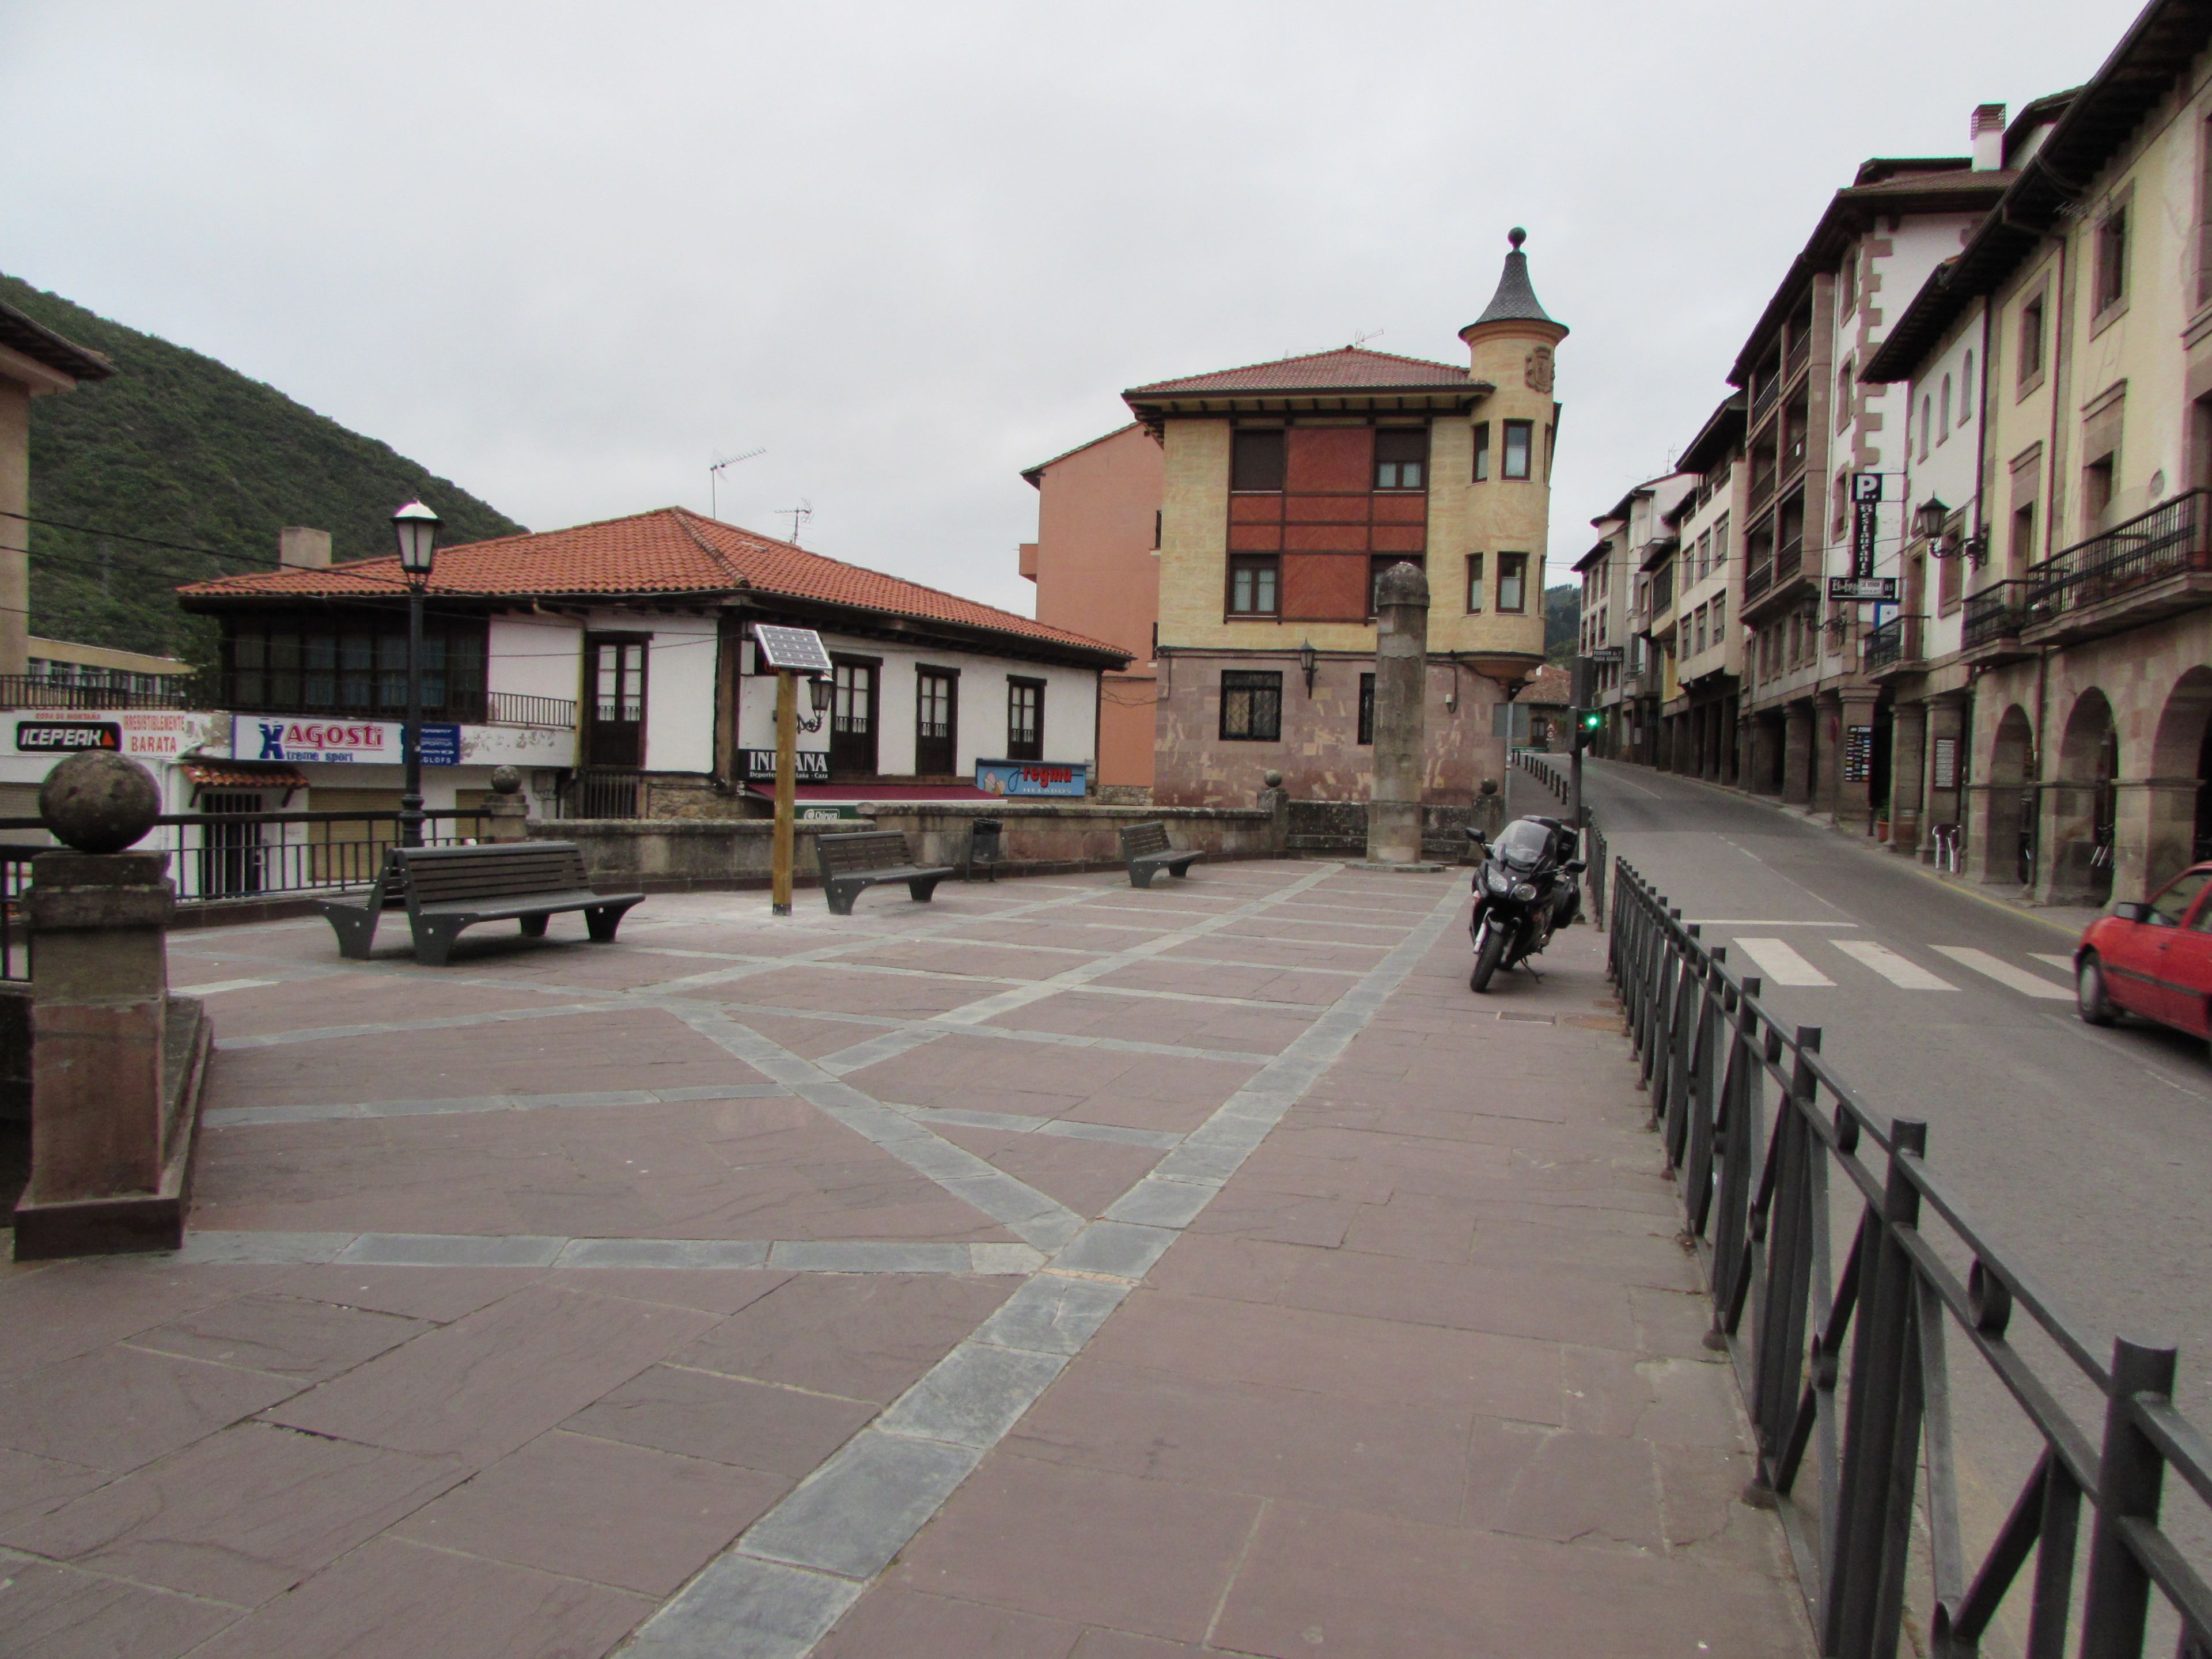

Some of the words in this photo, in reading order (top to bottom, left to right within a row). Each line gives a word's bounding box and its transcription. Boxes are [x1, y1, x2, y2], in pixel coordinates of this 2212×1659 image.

[21, 729, 102, 745] ICEPEAK
[131, 736, 177, 752] BARATA
[325, 752, 354, 762] sport
[750, 751, 828, 772] INANA
[1023, 767, 1072, 788] regma
